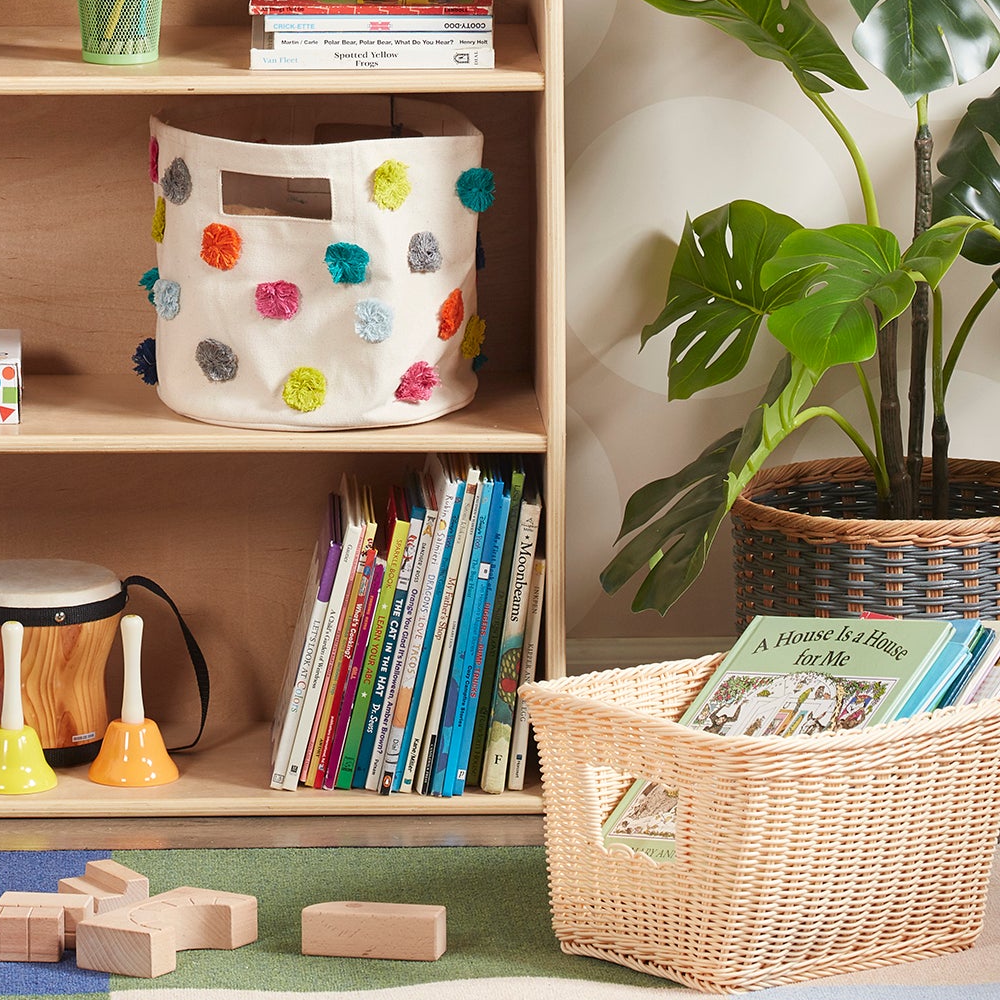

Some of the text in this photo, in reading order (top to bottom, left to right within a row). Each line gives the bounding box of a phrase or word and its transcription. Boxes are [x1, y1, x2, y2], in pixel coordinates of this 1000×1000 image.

[334, 51, 368, 60] Spotted
[355, 60, 379, 68] Frogs
[441, 494, 453, 517] Rubin
[430, 532, 445, 565] Salmieri
[385, 538, 402, 589] SPARKLE BOOK
[413, 569, 421, 583] ROSS
[470, 558, 478, 571] The
[446, 576, 456, 590] My
[510, 541, 532, 622] Moonbeams
[440, 591, 453, 620] Father's
[530, 585, 540, 614] INKPEN
[325, 615, 335, 634] Child's
[351, 602, 363, 627] What's
[406, 573, 435, 674] DRAGONS LOVE TACOS
[319, 634, 330, 655] Garden
[342, 627, 357, 659] Cooking?
[434, 620, 447, 641] Shop
[752, 626, 909, 661] A House Is a House
[363, 615, 385, 684] LEARN YOUR ABC
[374, 598, 403, 696] THE CAT IN THE HAT
[469, 602, 490, 698] DIGGERS DUMP TRUCKS
[793, 648, 850, 667] for Me
[290, 620, 320, 713] LET'S LOOK AT Colors
[311, 662, 323, 689] Weirdness
[350, 666, 358, 680] GILL
[376, 588, 417, 753] Orange You Glad It's Halloween, Amber Brown?
[523, 643, 534, 684] KIPPER AN
[457, 664, 472, 727] Cozy Campfire Stories
[366, 702, 380, 734] Dr. Seuss
[406, 737, 419, 772] Kane/Miller
[494, 754, 503, 765] F
[631, 847, 657, 858] MRY
